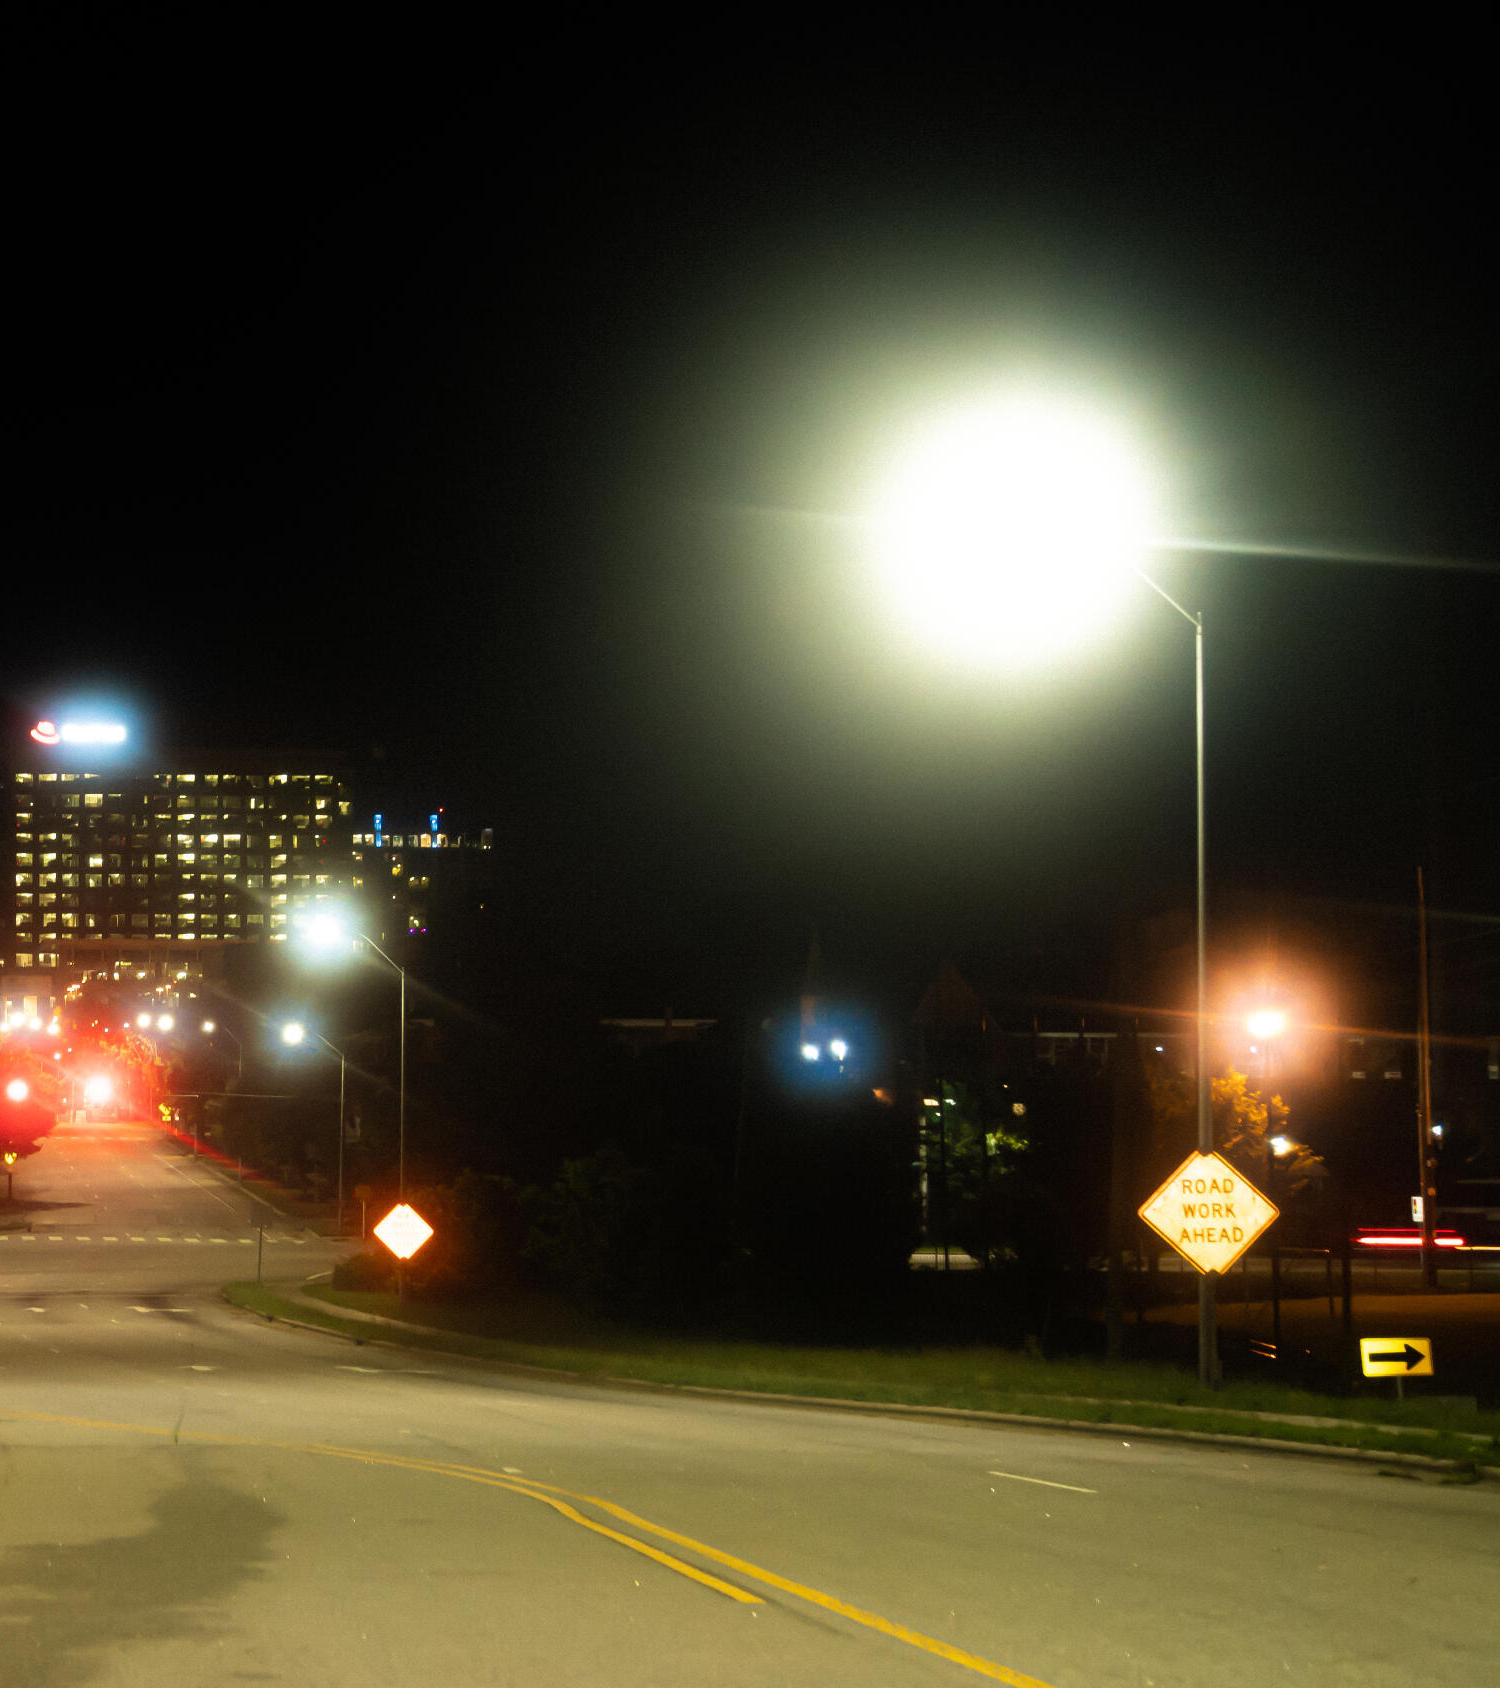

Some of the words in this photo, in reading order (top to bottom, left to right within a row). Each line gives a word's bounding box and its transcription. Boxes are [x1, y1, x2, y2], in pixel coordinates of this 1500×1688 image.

[1181, 1178, 1235, 1194] ROAD
[1182, 1203, 1237, 1219] WORK
[1179, 1226, 1245, 1243] AHEAD
